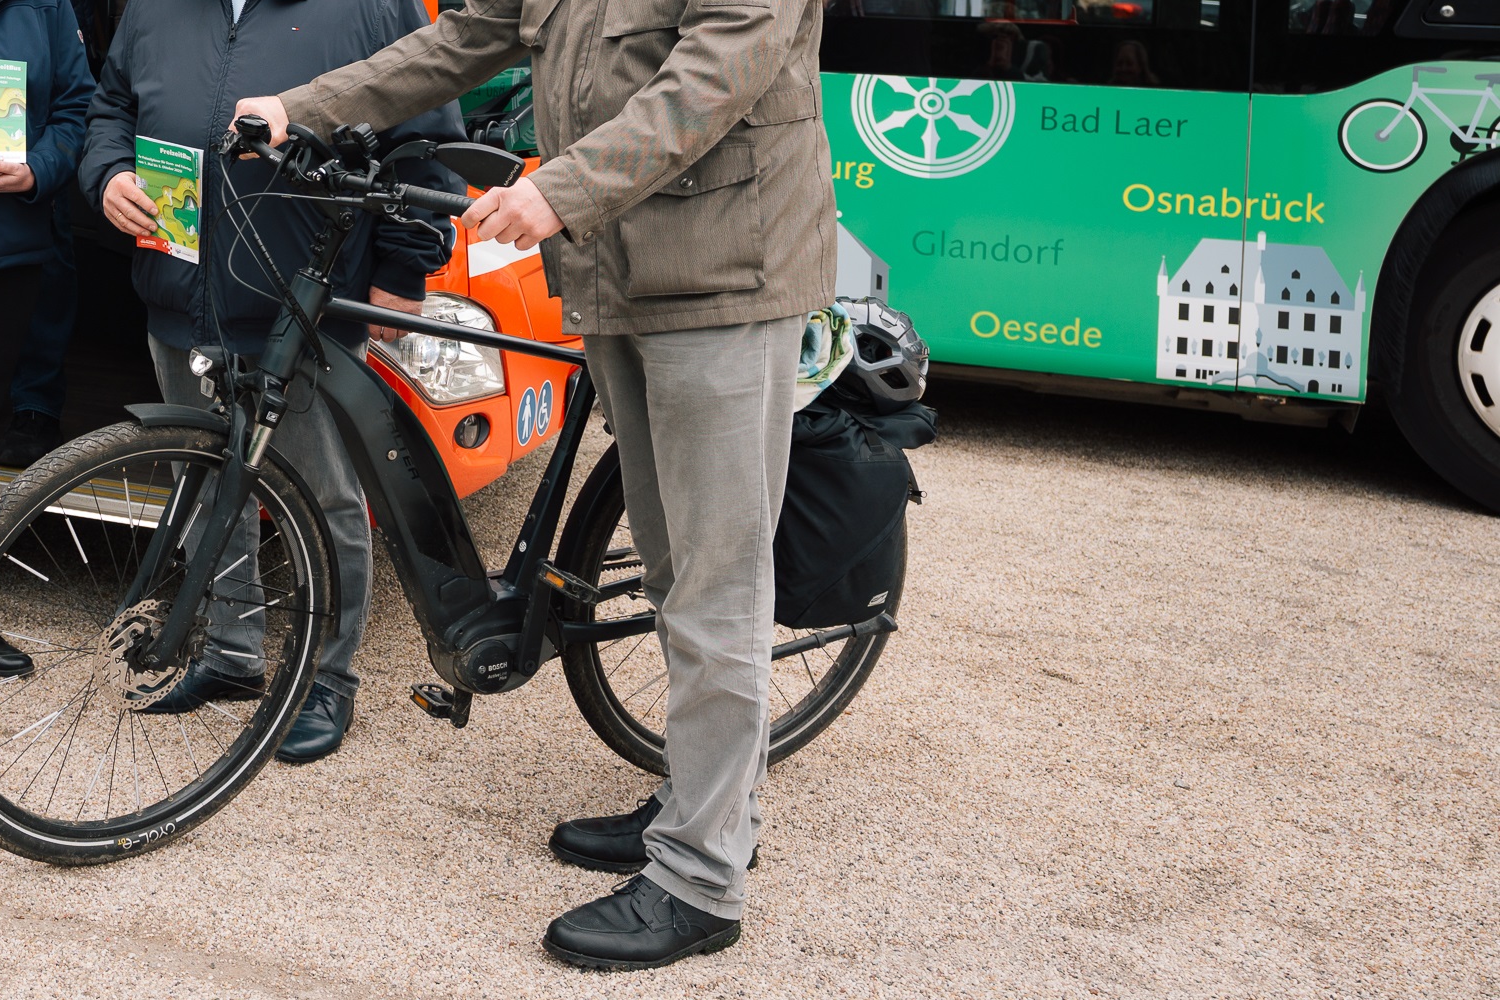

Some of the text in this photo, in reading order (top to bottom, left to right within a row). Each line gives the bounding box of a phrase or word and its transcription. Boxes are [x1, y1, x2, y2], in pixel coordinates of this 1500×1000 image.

[1040, 101, 1189, 140] Bad Laer
[159, 147, 191, 162] FreizeitBus
[832, 161, 876, 189] urg
[1122, 183, 1325, 225] Osnabrück
[911, 229, 1065, 267] Glandorf
[970, 310, 1102, 349] Oesede
[488, 662, 507, 672] BOSCH
